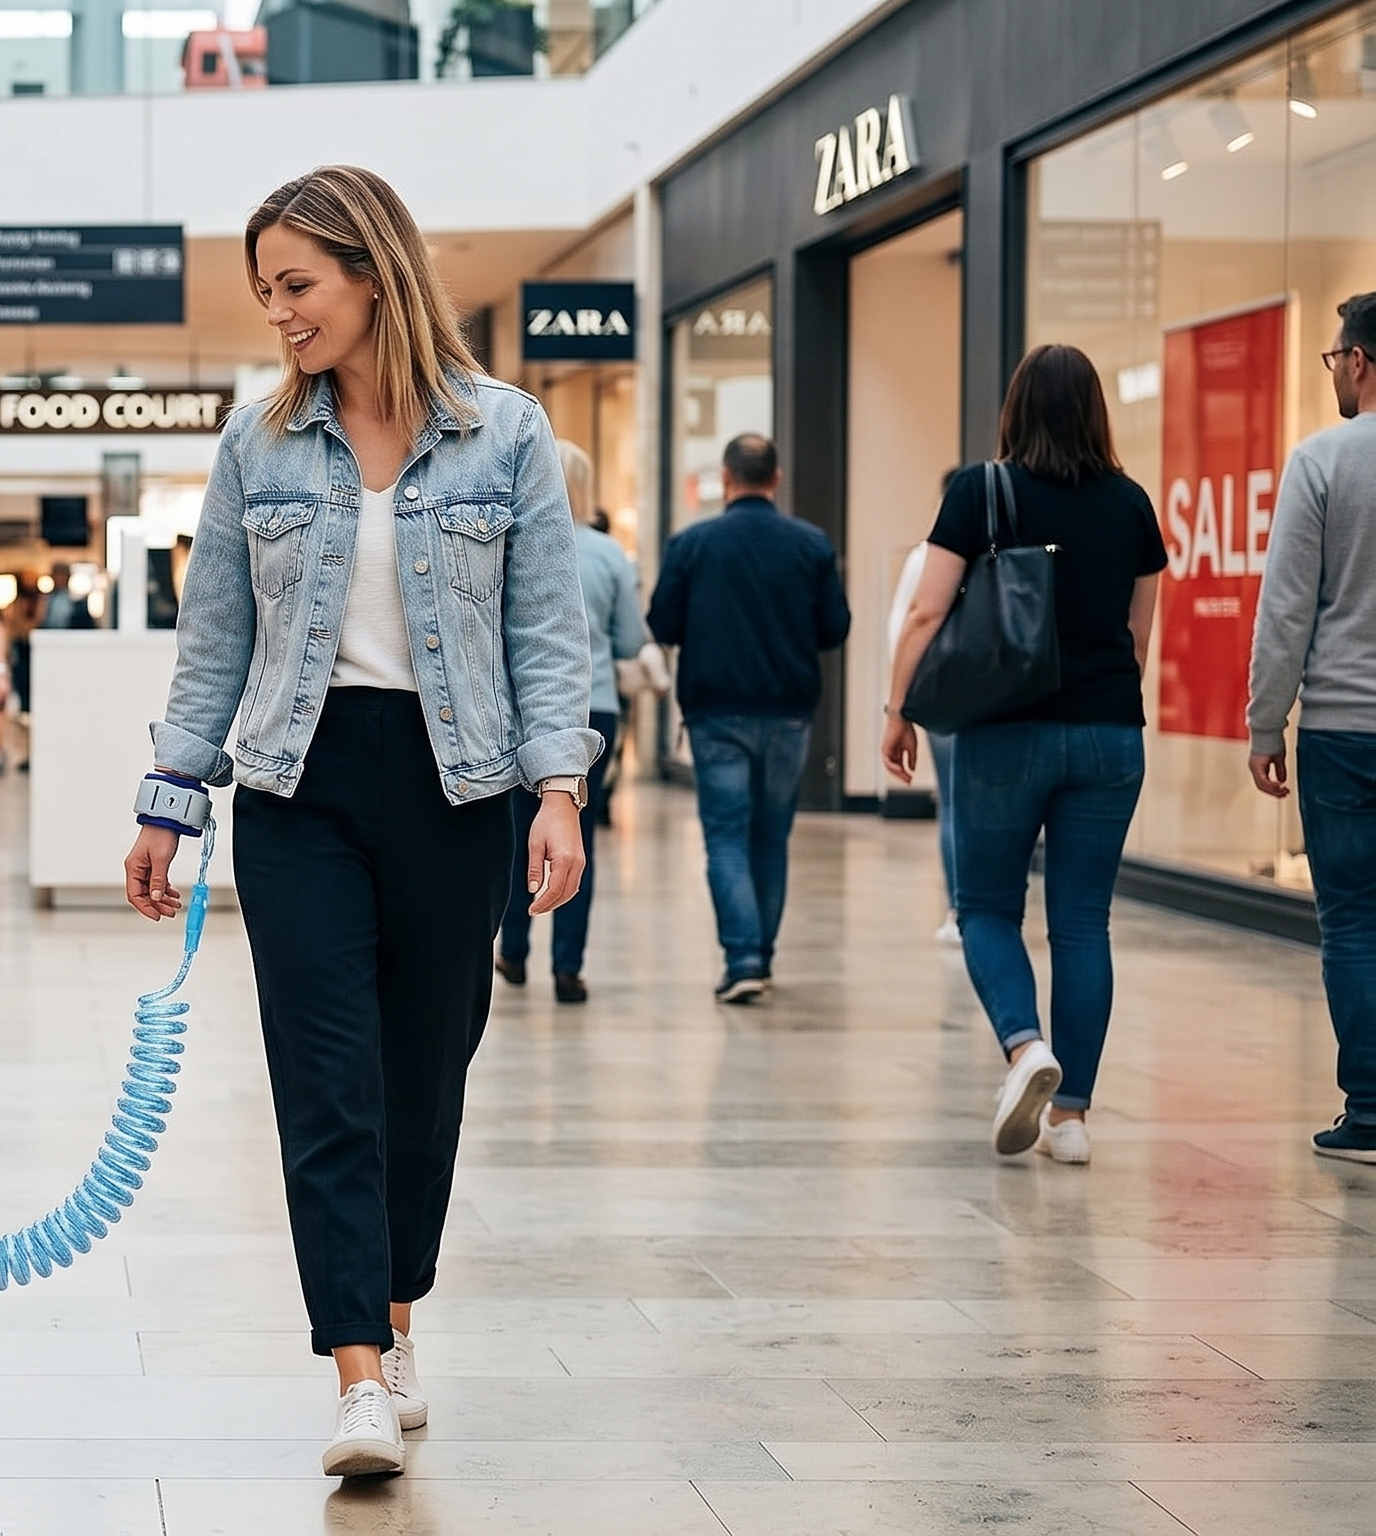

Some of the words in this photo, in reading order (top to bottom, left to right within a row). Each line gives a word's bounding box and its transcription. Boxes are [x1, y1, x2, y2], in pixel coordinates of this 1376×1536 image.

[814, 94, 914, 216] ZARA
[527, 308, 630, 336] ZARA
[0, 393, 100, 429] FOOD
[102, 393, 223, 429] COURT
[1167, 468, 1274, 581] SALE
